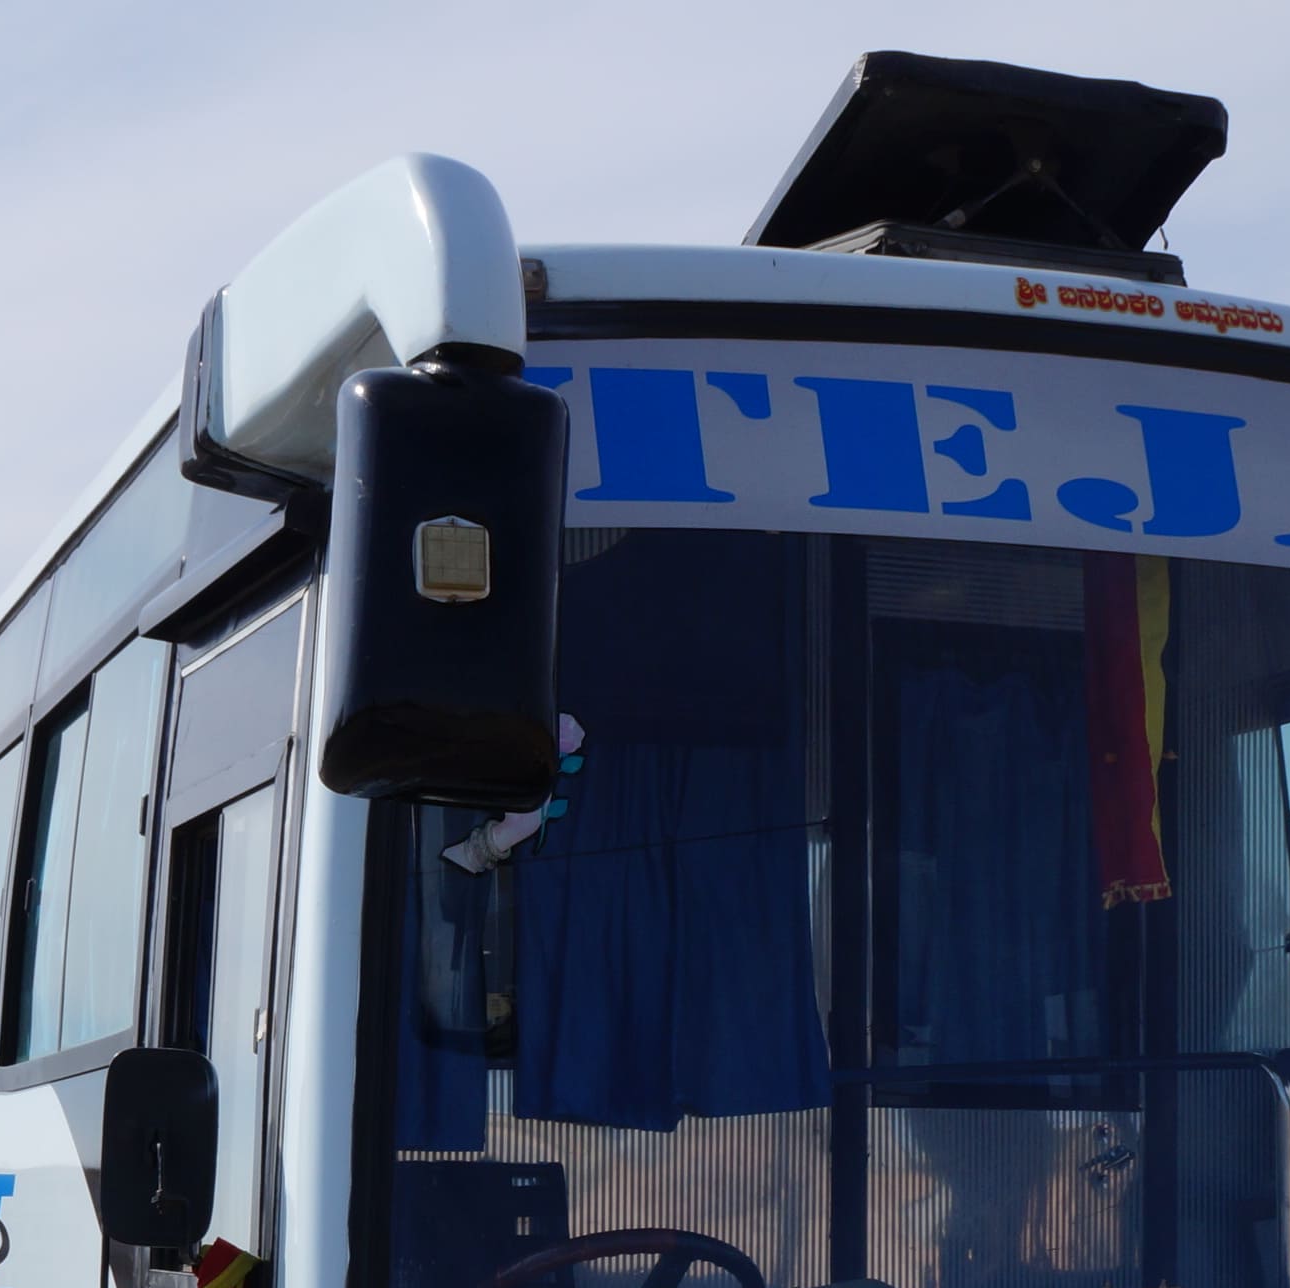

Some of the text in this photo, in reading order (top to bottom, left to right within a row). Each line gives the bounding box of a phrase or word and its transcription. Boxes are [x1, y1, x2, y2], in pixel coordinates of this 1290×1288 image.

[1016, 277, 1283, 333] ಶ್ರೀ ಬನಶಂಕರಿ ಅಮ್ಮನವರು
